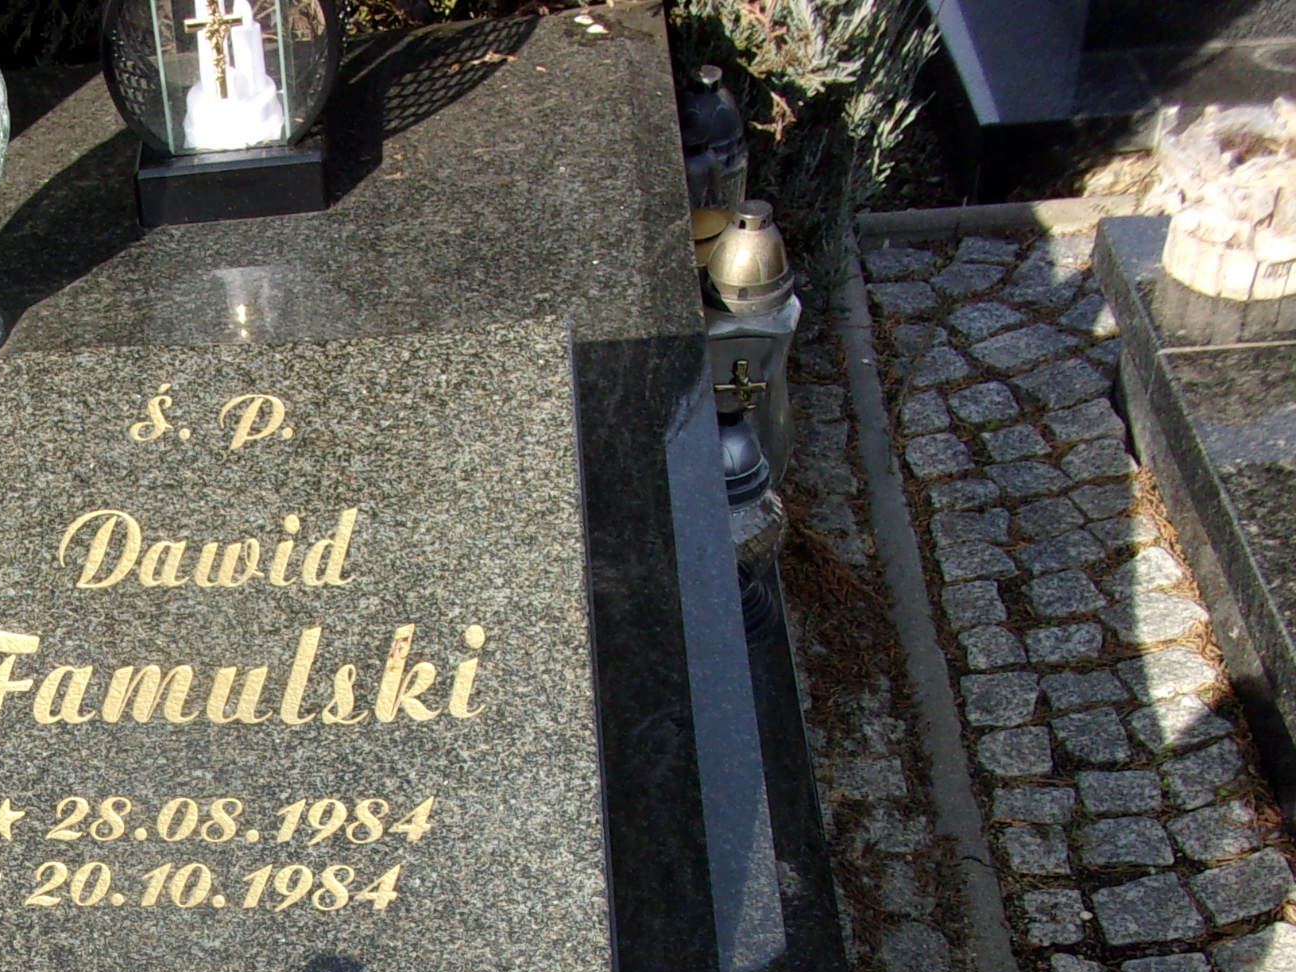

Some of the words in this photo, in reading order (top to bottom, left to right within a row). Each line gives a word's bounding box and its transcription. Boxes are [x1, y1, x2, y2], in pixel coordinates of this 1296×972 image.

[58, 506, 359, 590] Dawid
[45, 795, 437, 846] 28.08.1984
[24, 860, 404, 912] 20.10.1984
